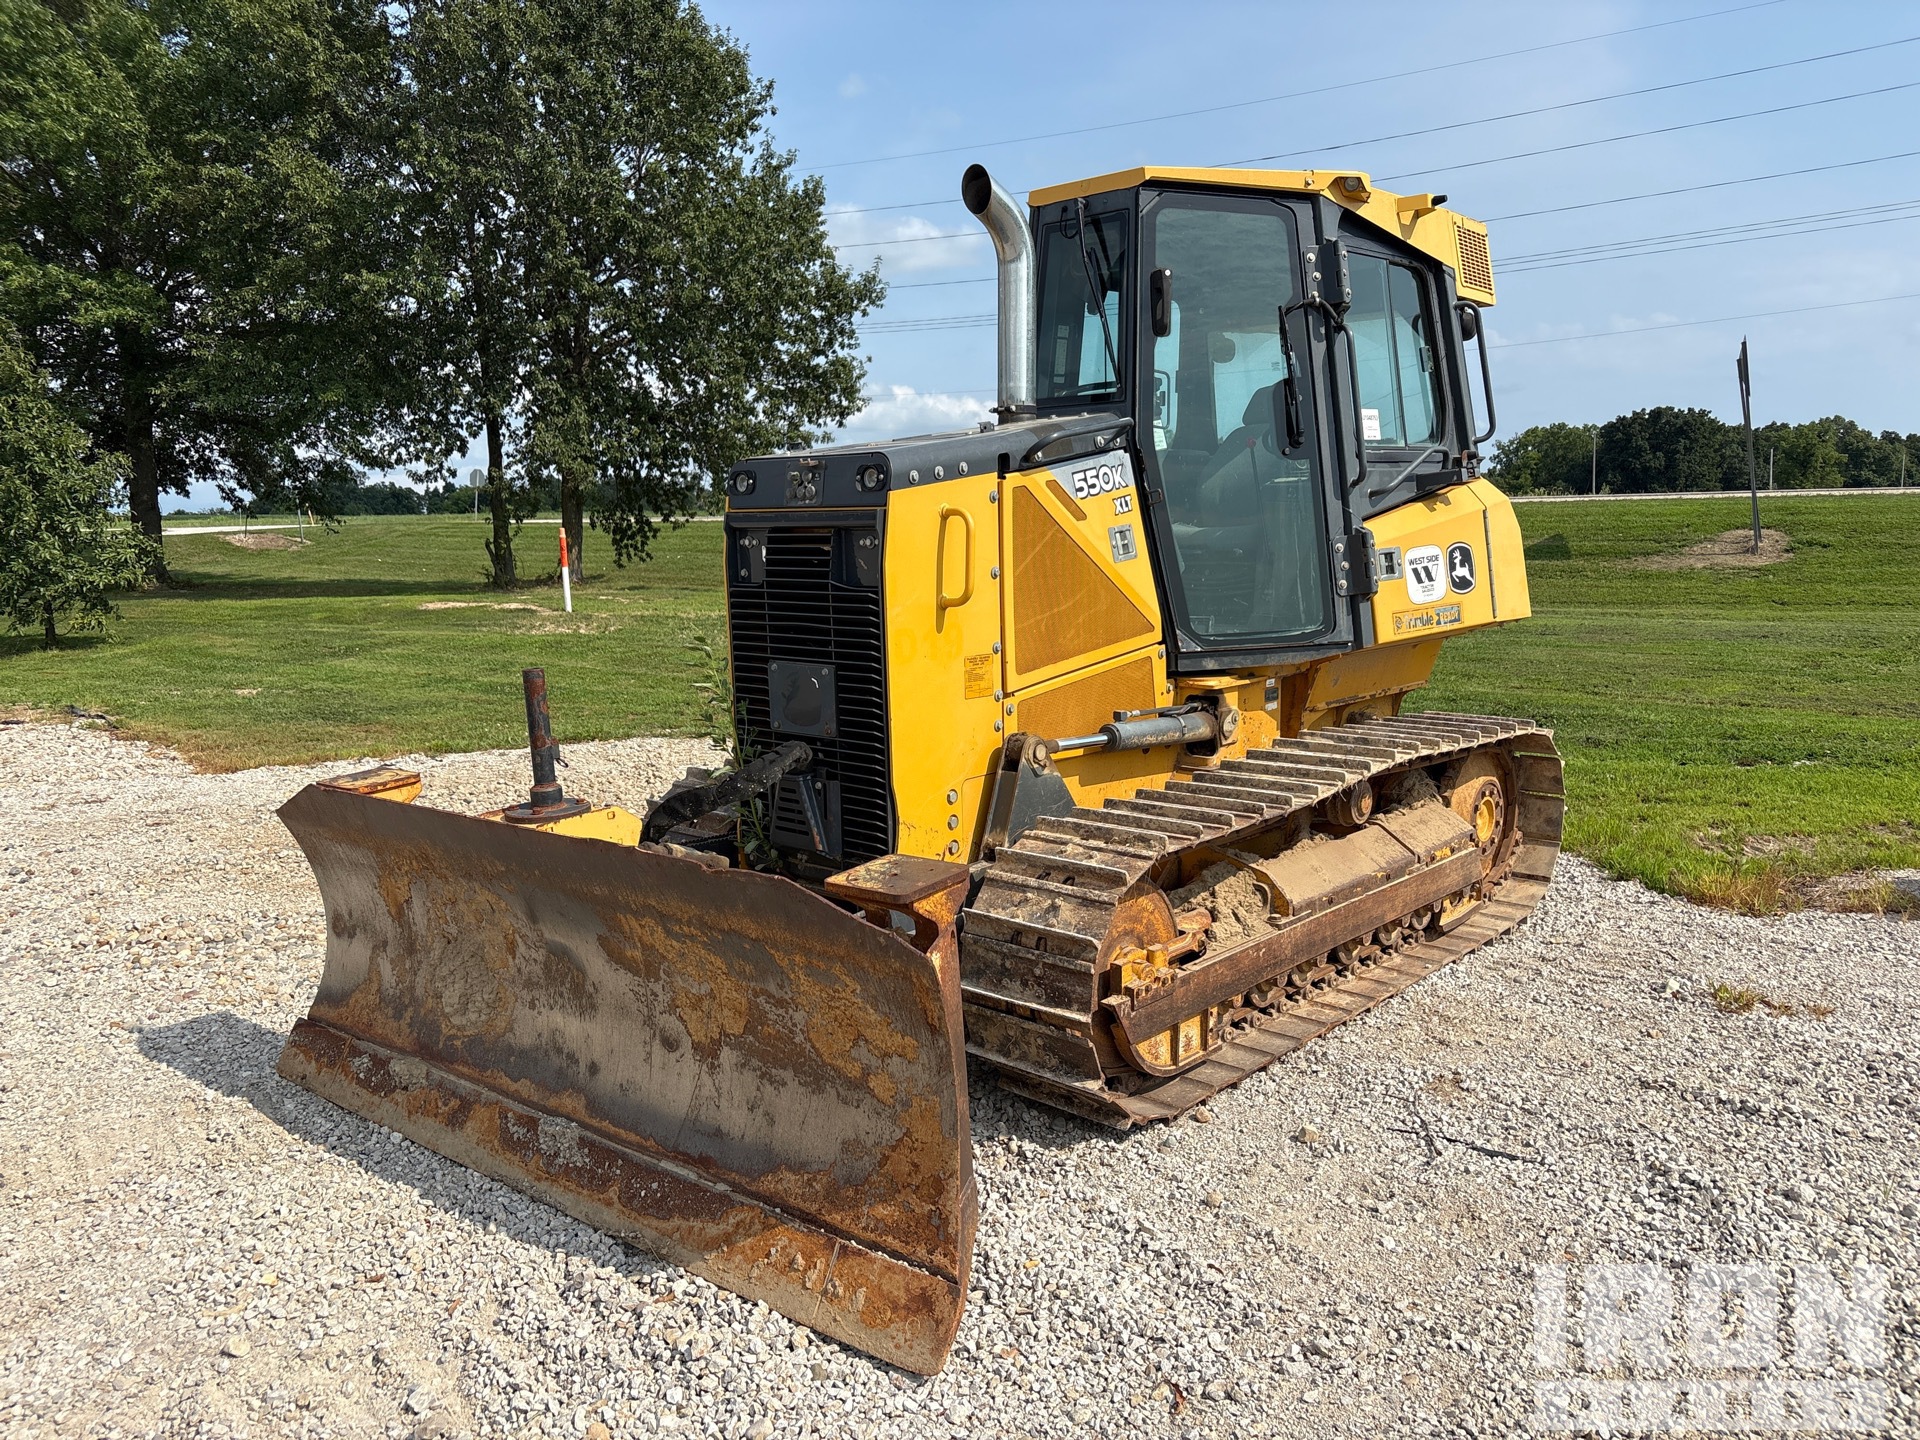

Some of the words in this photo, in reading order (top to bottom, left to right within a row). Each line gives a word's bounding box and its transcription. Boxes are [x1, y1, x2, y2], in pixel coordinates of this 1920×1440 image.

[1072, 464, 1129, 500] 550K
[1112, 494, 1133, 516] XLT
[1407, 556, 1425, 566] WEST
[1426, 554, 1440, 564] SIDE
